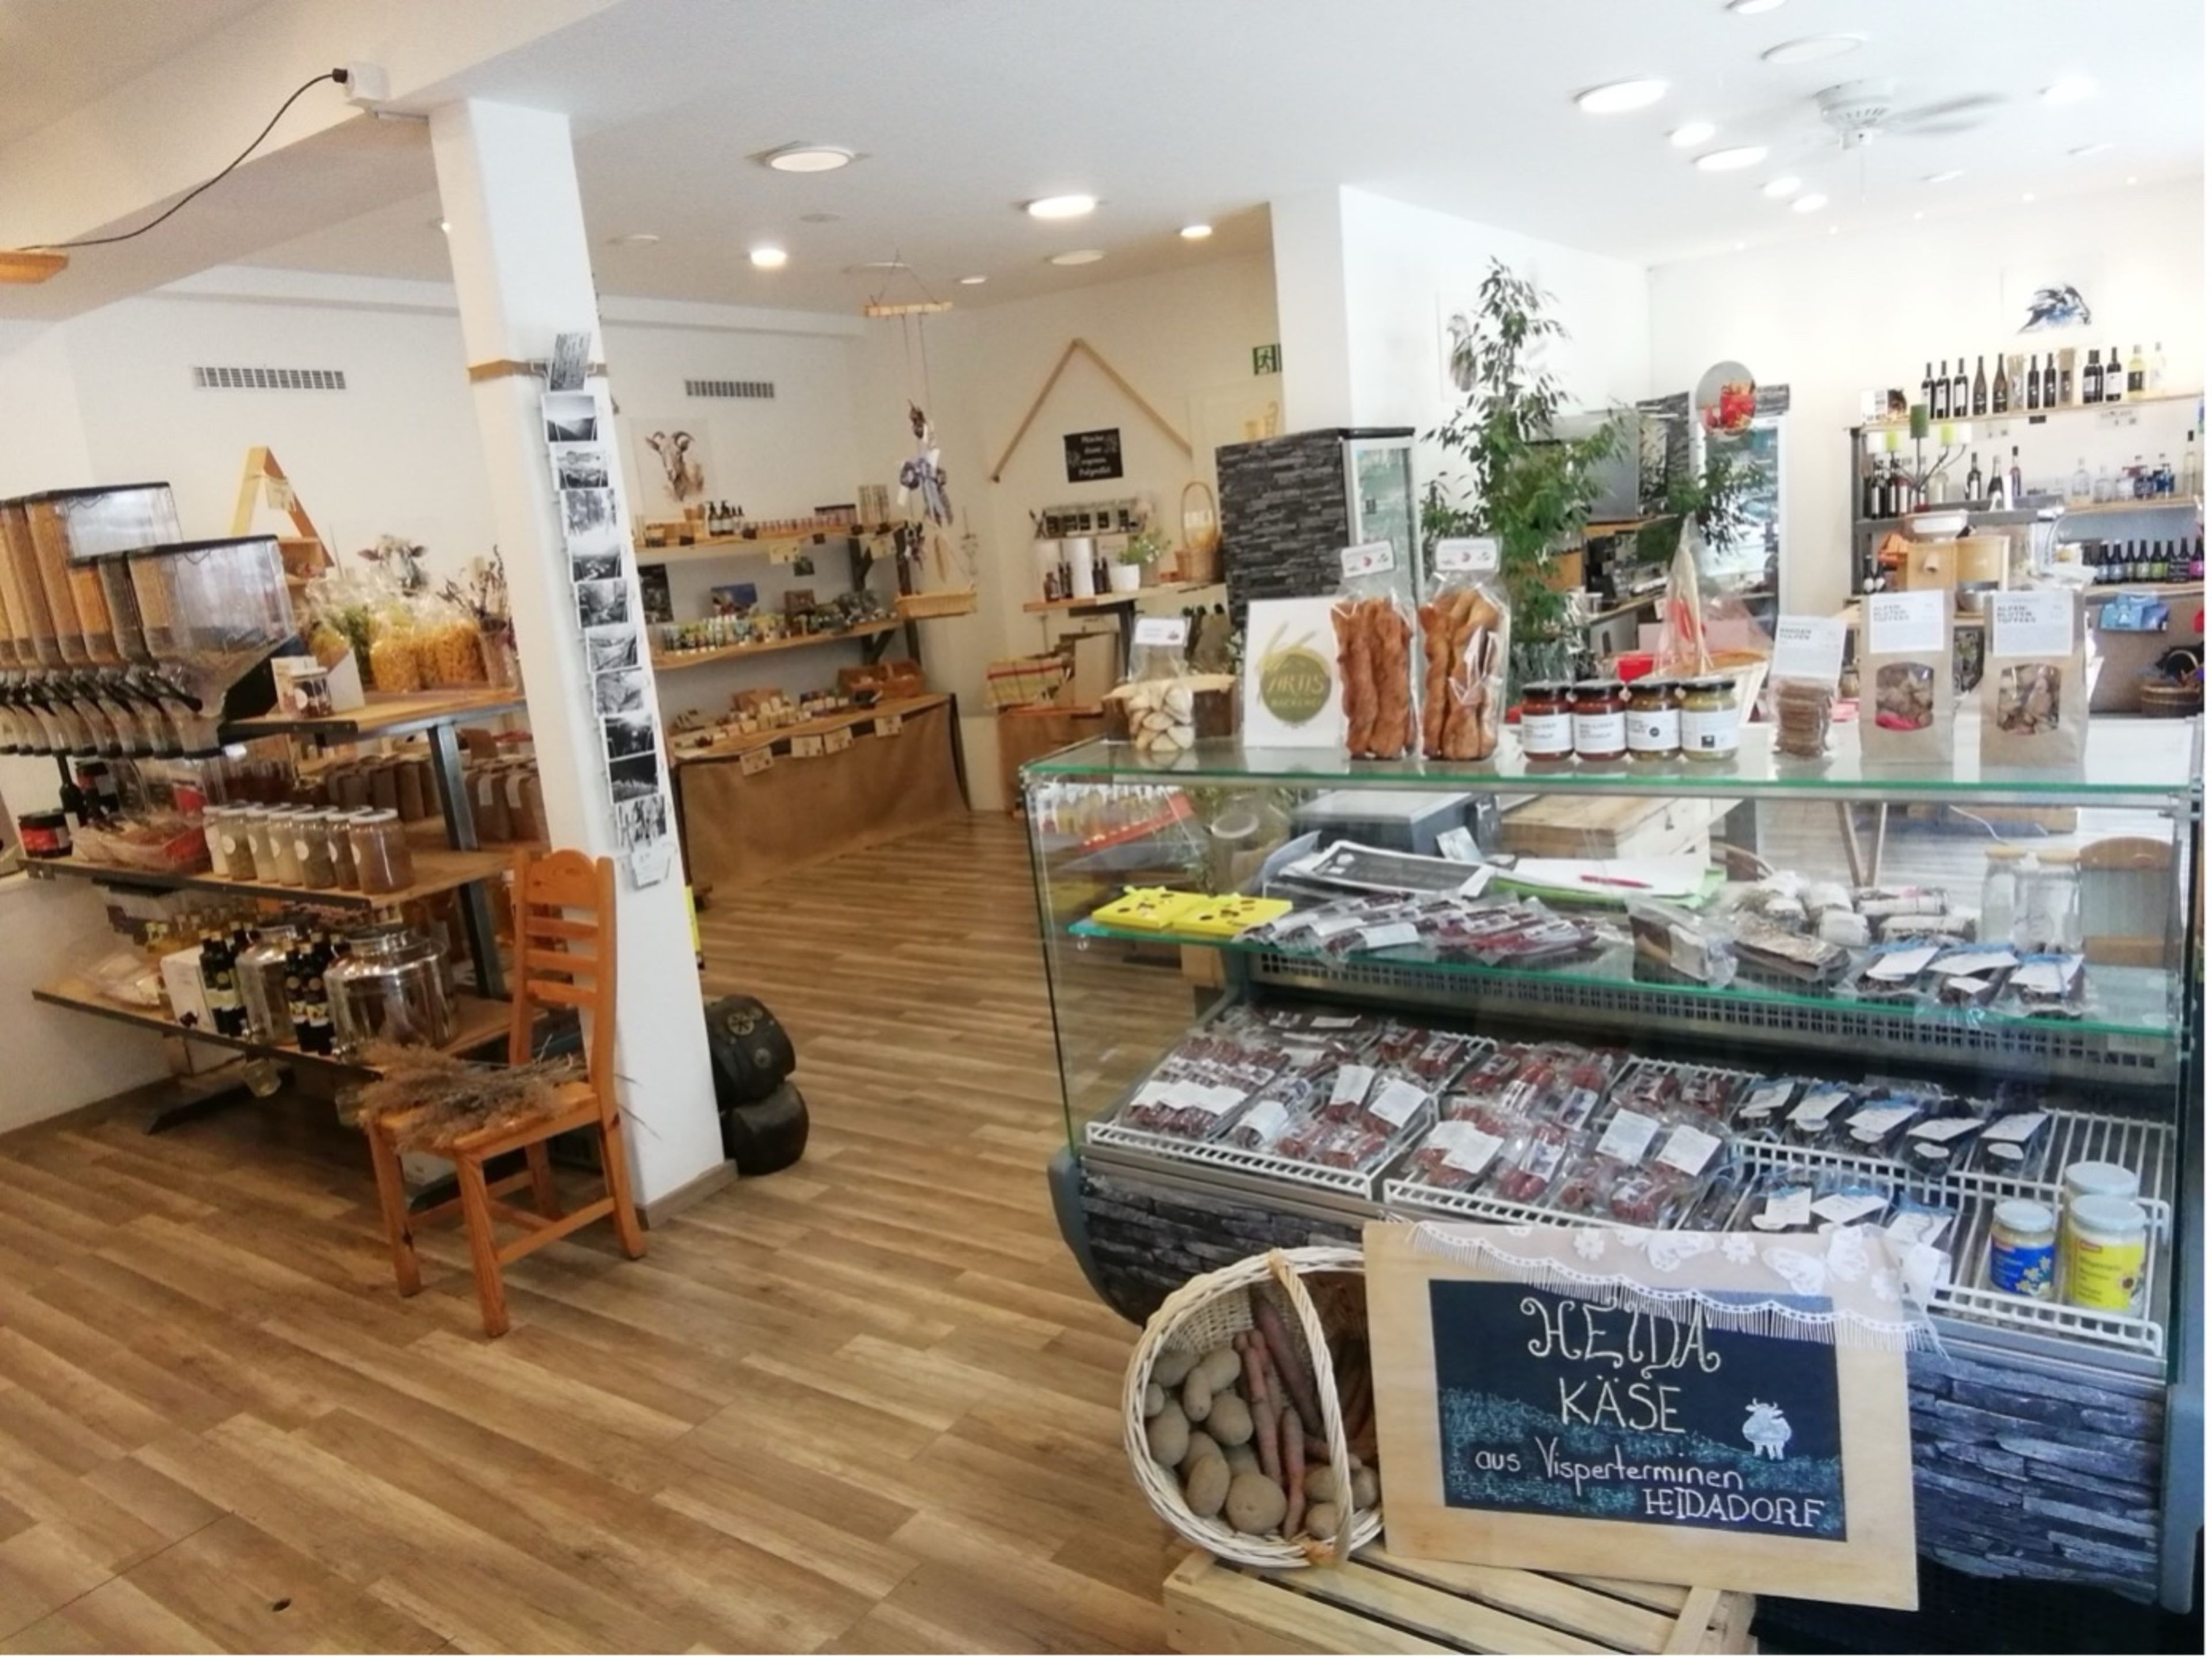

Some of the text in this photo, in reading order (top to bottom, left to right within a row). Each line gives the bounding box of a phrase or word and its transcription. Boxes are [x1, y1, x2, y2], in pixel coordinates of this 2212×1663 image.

[1520, 1296, 1721, 1380] HEIDA
[1559, 1374, 1687, 1433] KÄSE
[1475, 1436, 1745, 1498] aus Visperterminen
[1643, 1488, 1825, 1528] HEIDADORF
